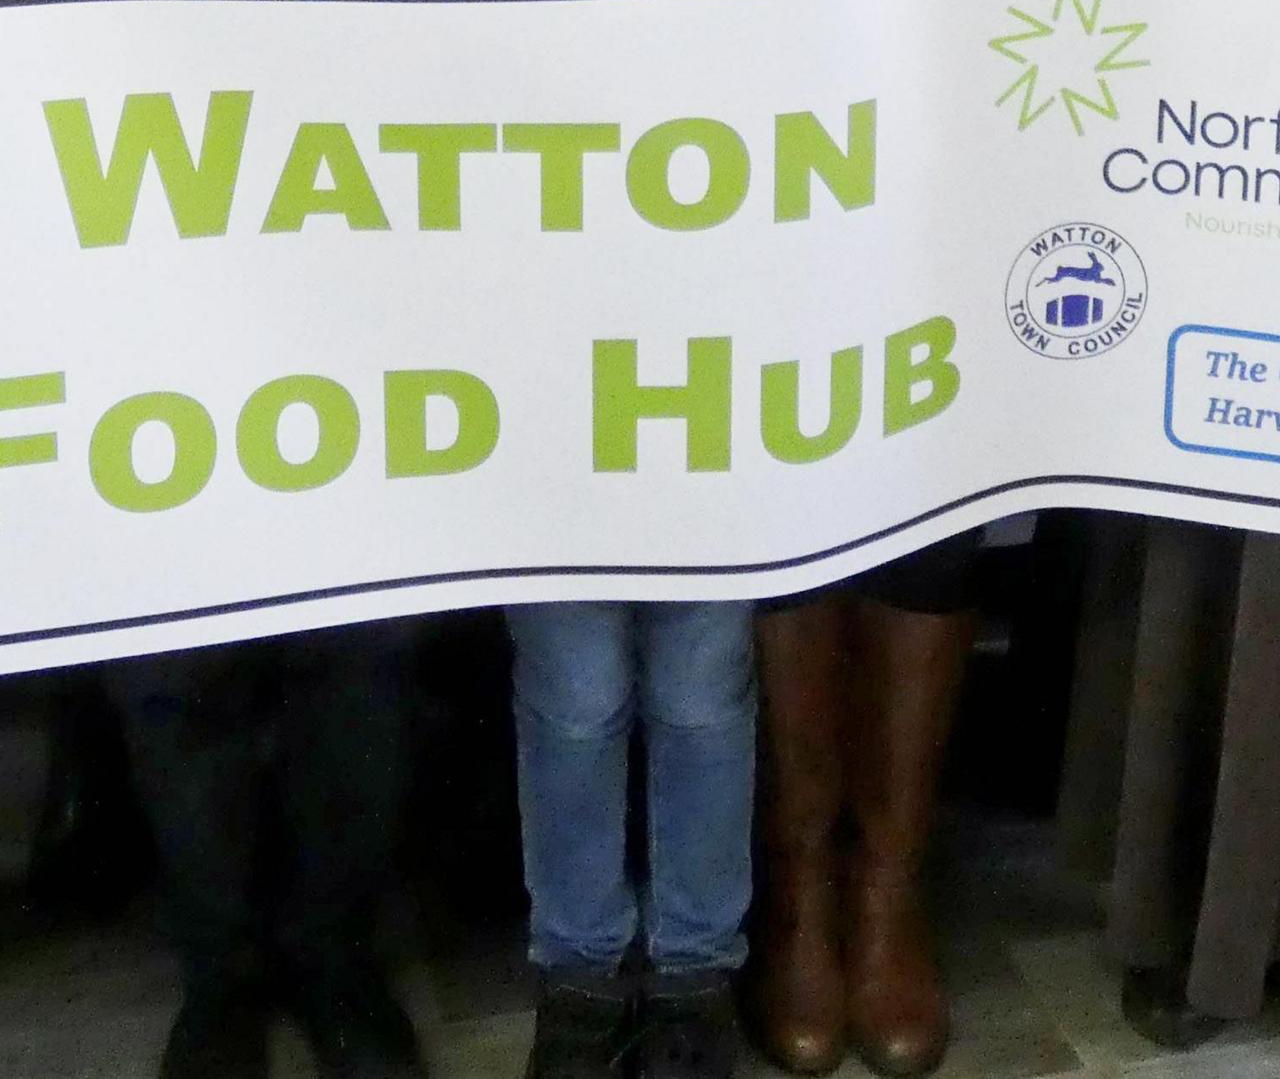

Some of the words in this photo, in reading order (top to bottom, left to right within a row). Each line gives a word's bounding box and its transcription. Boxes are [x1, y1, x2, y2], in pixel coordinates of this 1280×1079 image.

[1029, 227, 1123, 257] WATTON
[1008, 299, 1051, 352] TOWN
[1067, 291, 1143, 356] COUNCIL
[1205, 351, 1267, 382] The
